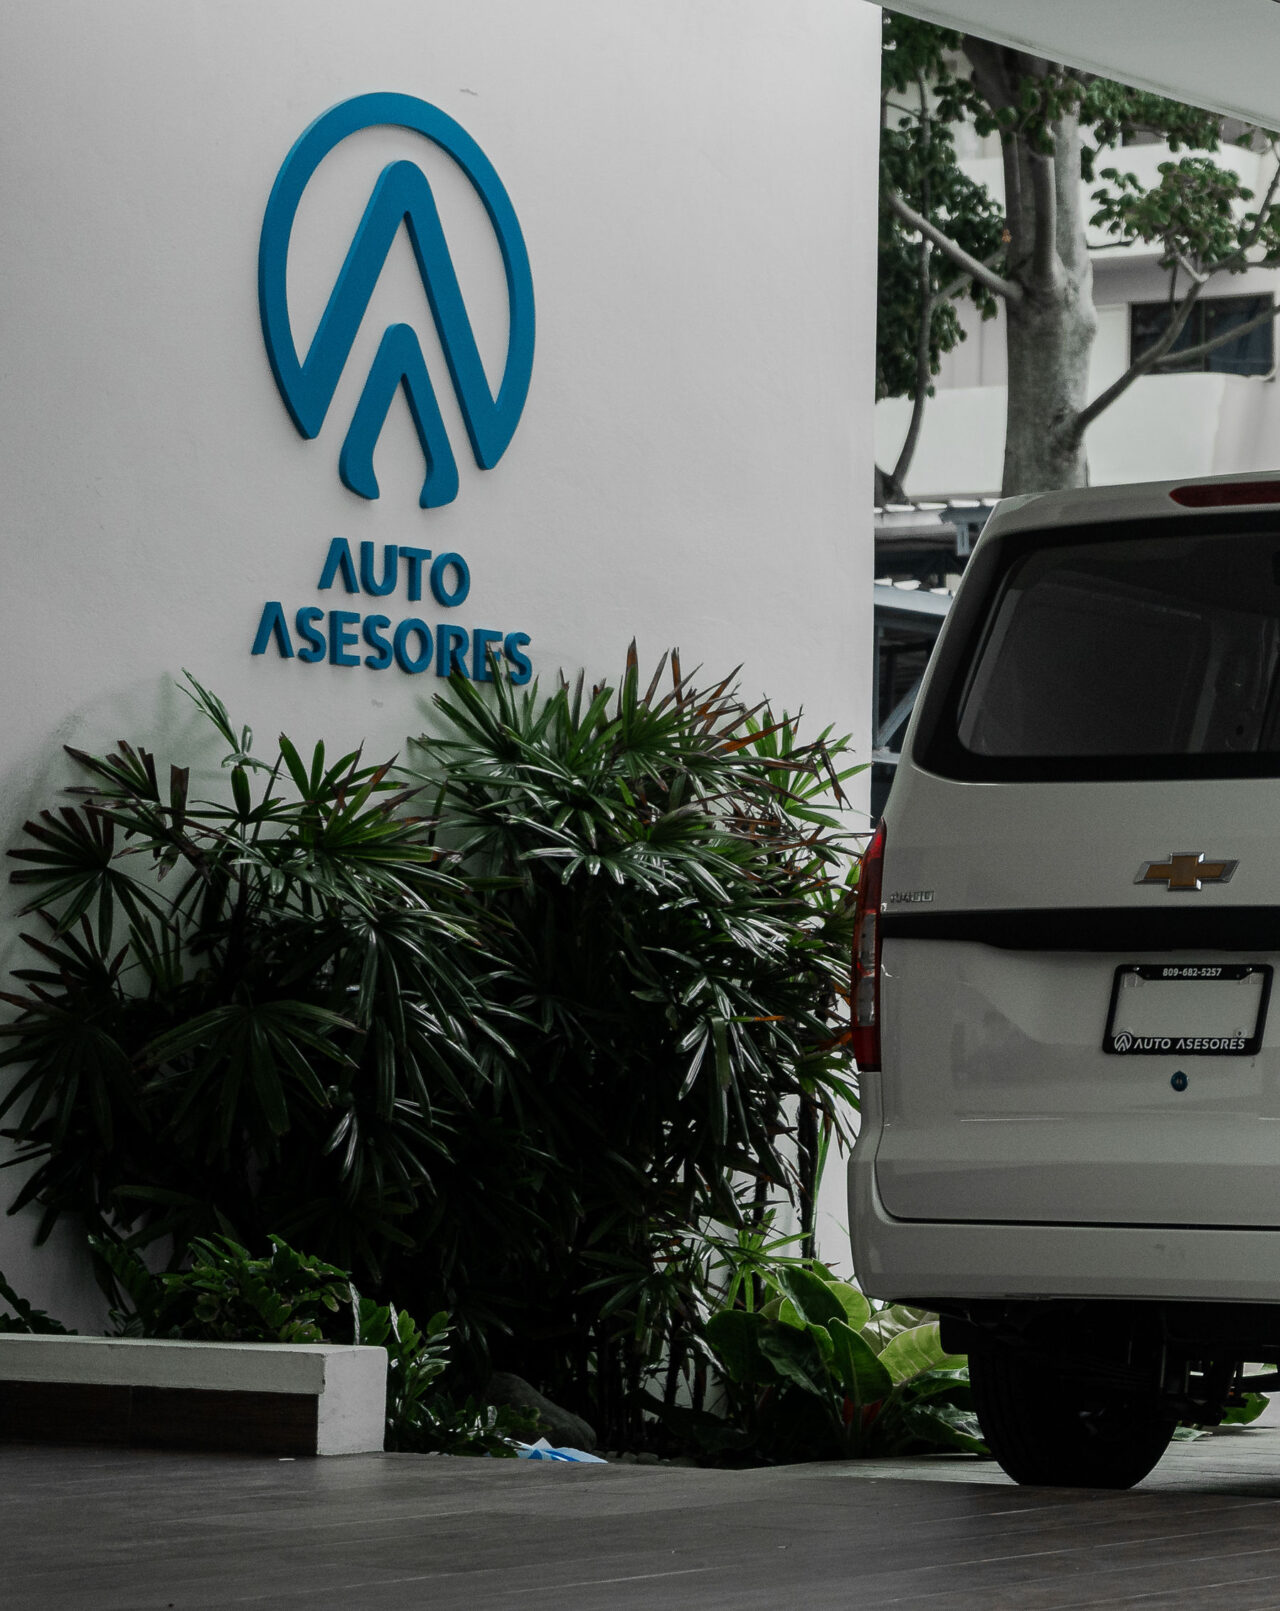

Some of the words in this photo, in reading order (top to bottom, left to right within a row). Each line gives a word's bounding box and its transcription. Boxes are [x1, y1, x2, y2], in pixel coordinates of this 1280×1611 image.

[317, 537, 471, 607] AUTO
[251, 601, 533, 686] ASESORES
[1162, 967, 1223, 977] 809-682-5257
[1133, 1038, 1172, 1051] AUTO
[1175, 1038, 1246, 1051] ASESORES
